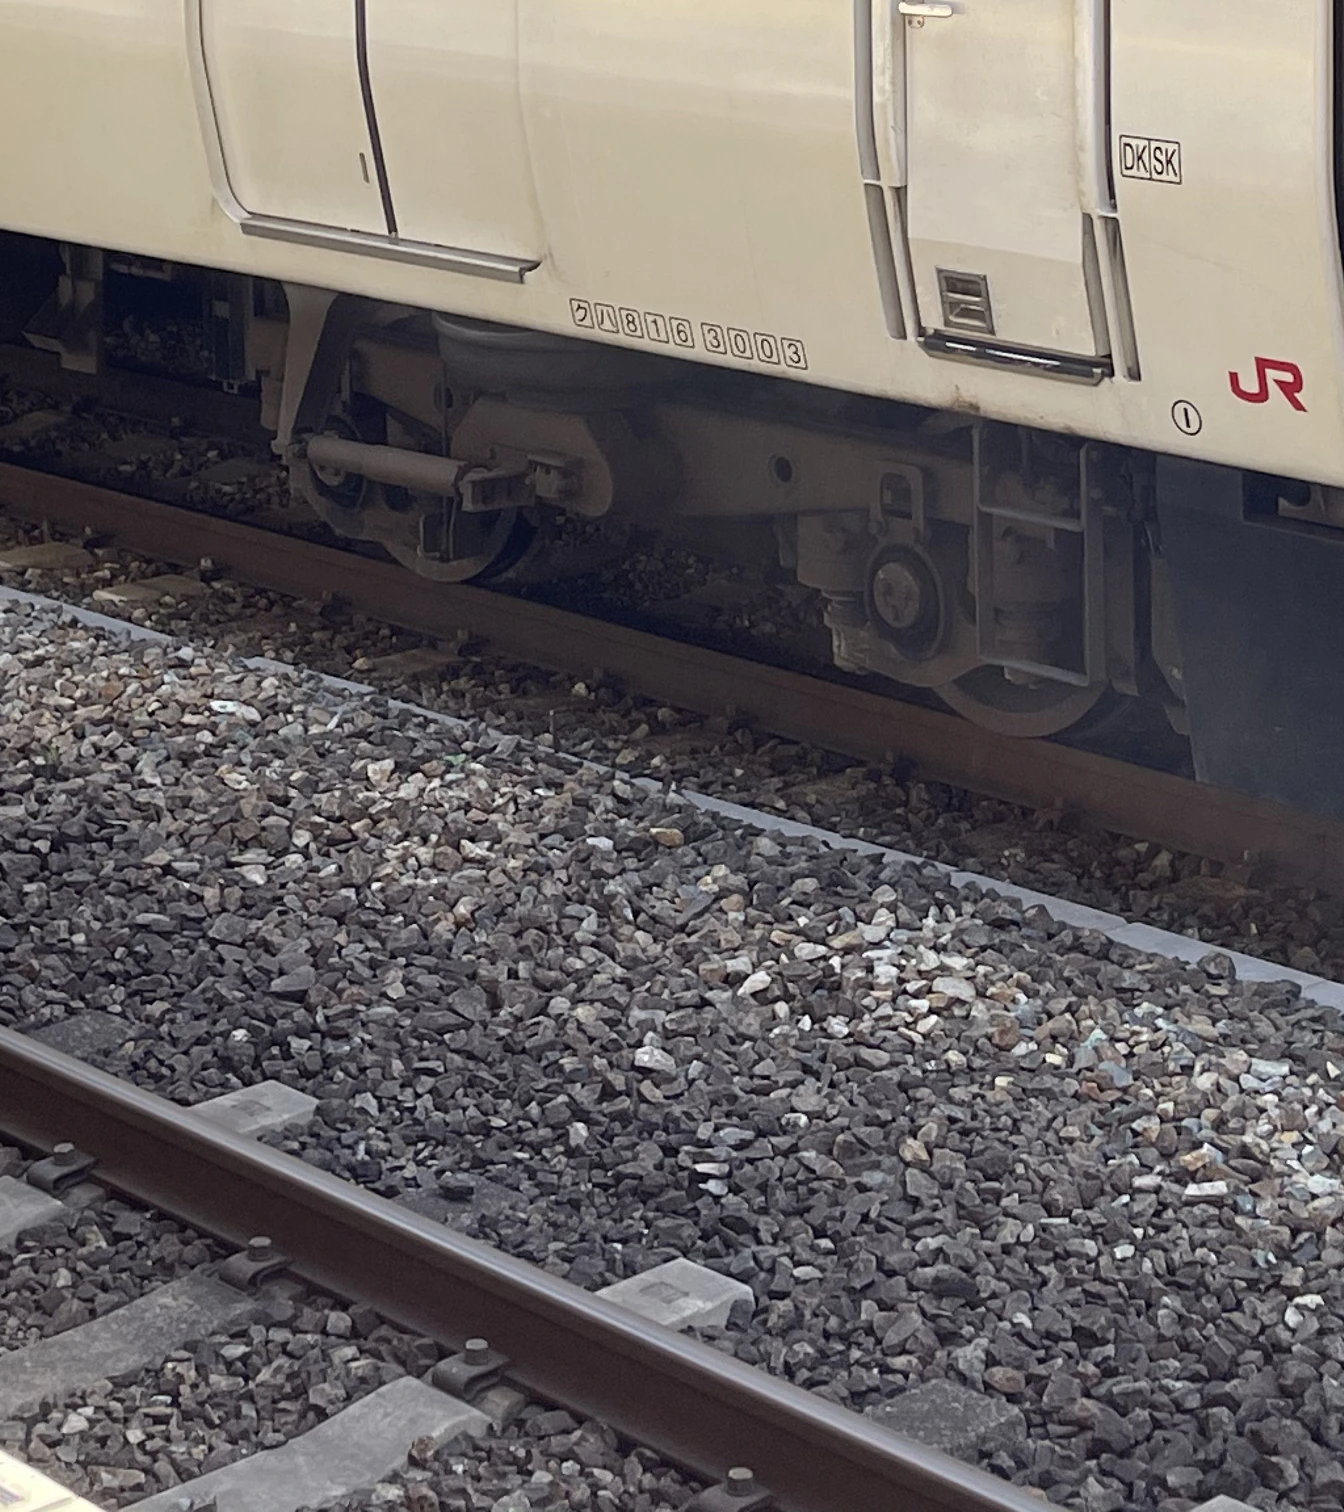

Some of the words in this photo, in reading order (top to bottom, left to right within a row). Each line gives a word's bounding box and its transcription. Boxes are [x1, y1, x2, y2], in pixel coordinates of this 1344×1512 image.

[1122, 142, 1150, 174] DK
[1152, 145, 1179, 178] SK
[1228, 356, 1308, 413] JR
